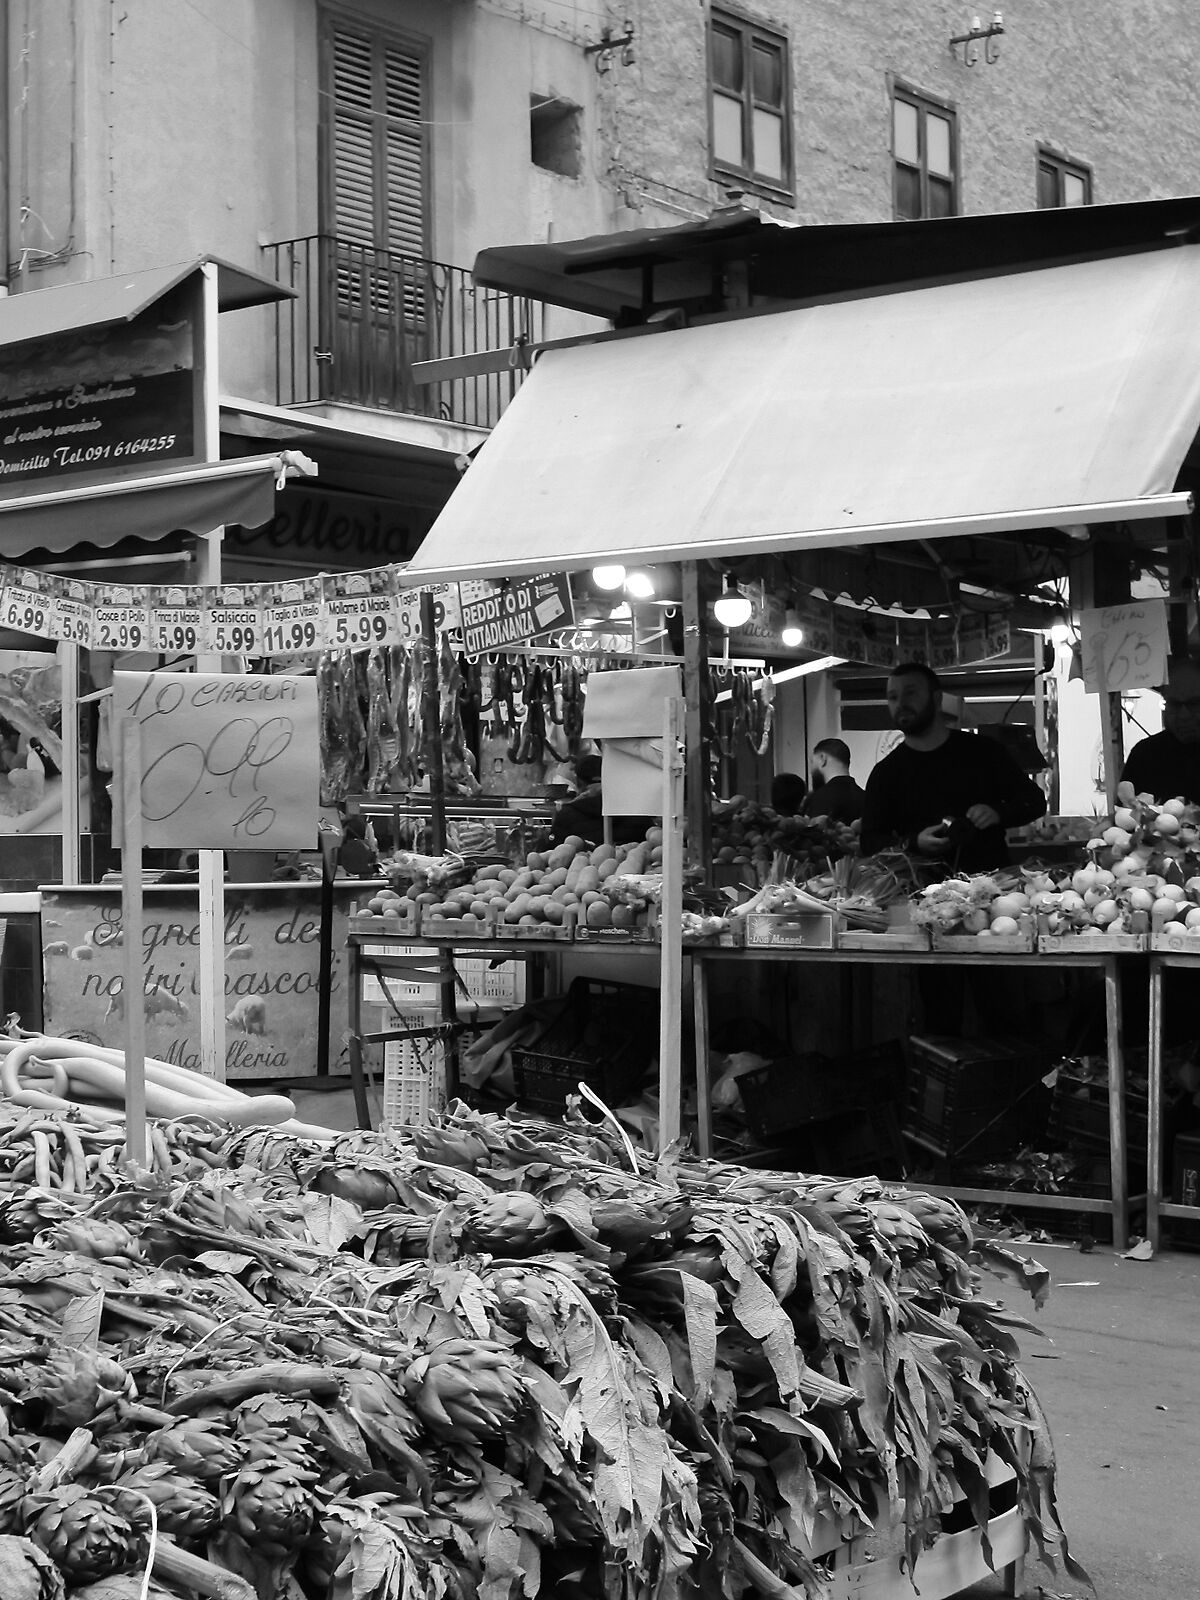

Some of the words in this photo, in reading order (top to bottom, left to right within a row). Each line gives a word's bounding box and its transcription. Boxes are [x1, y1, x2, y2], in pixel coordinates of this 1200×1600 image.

[113, 434, 176, 457] 6164255
[8, 603, 44, 631] 6.99
[96, 609, 119, 622] Cosce
[120, 610, 127, 622] di
[129, 610, 146, 622] Pollo
[211, 610, 257, 623] Salsiccia
[462, 594, 516, 627] REDDIO
[517, 588, 532, 609] DI
[63, 616, 90, 643] 5.99
[100, 625, 142, 649] 2.99
[159, 626, 197, 650] 5.99
[216, 627, 255, 651] 5.99
[264, 622, 316, 652] 11.99
[336, 615, 387, 644] 5.99
[466, 611, 535, 653] CITTADINANZA
[92, 903, 249, 964] gneli
[275, 904, 321, 945] de
[81, 962, 185, 996] notri
[152, 1038, 288, 1069] Malleria
